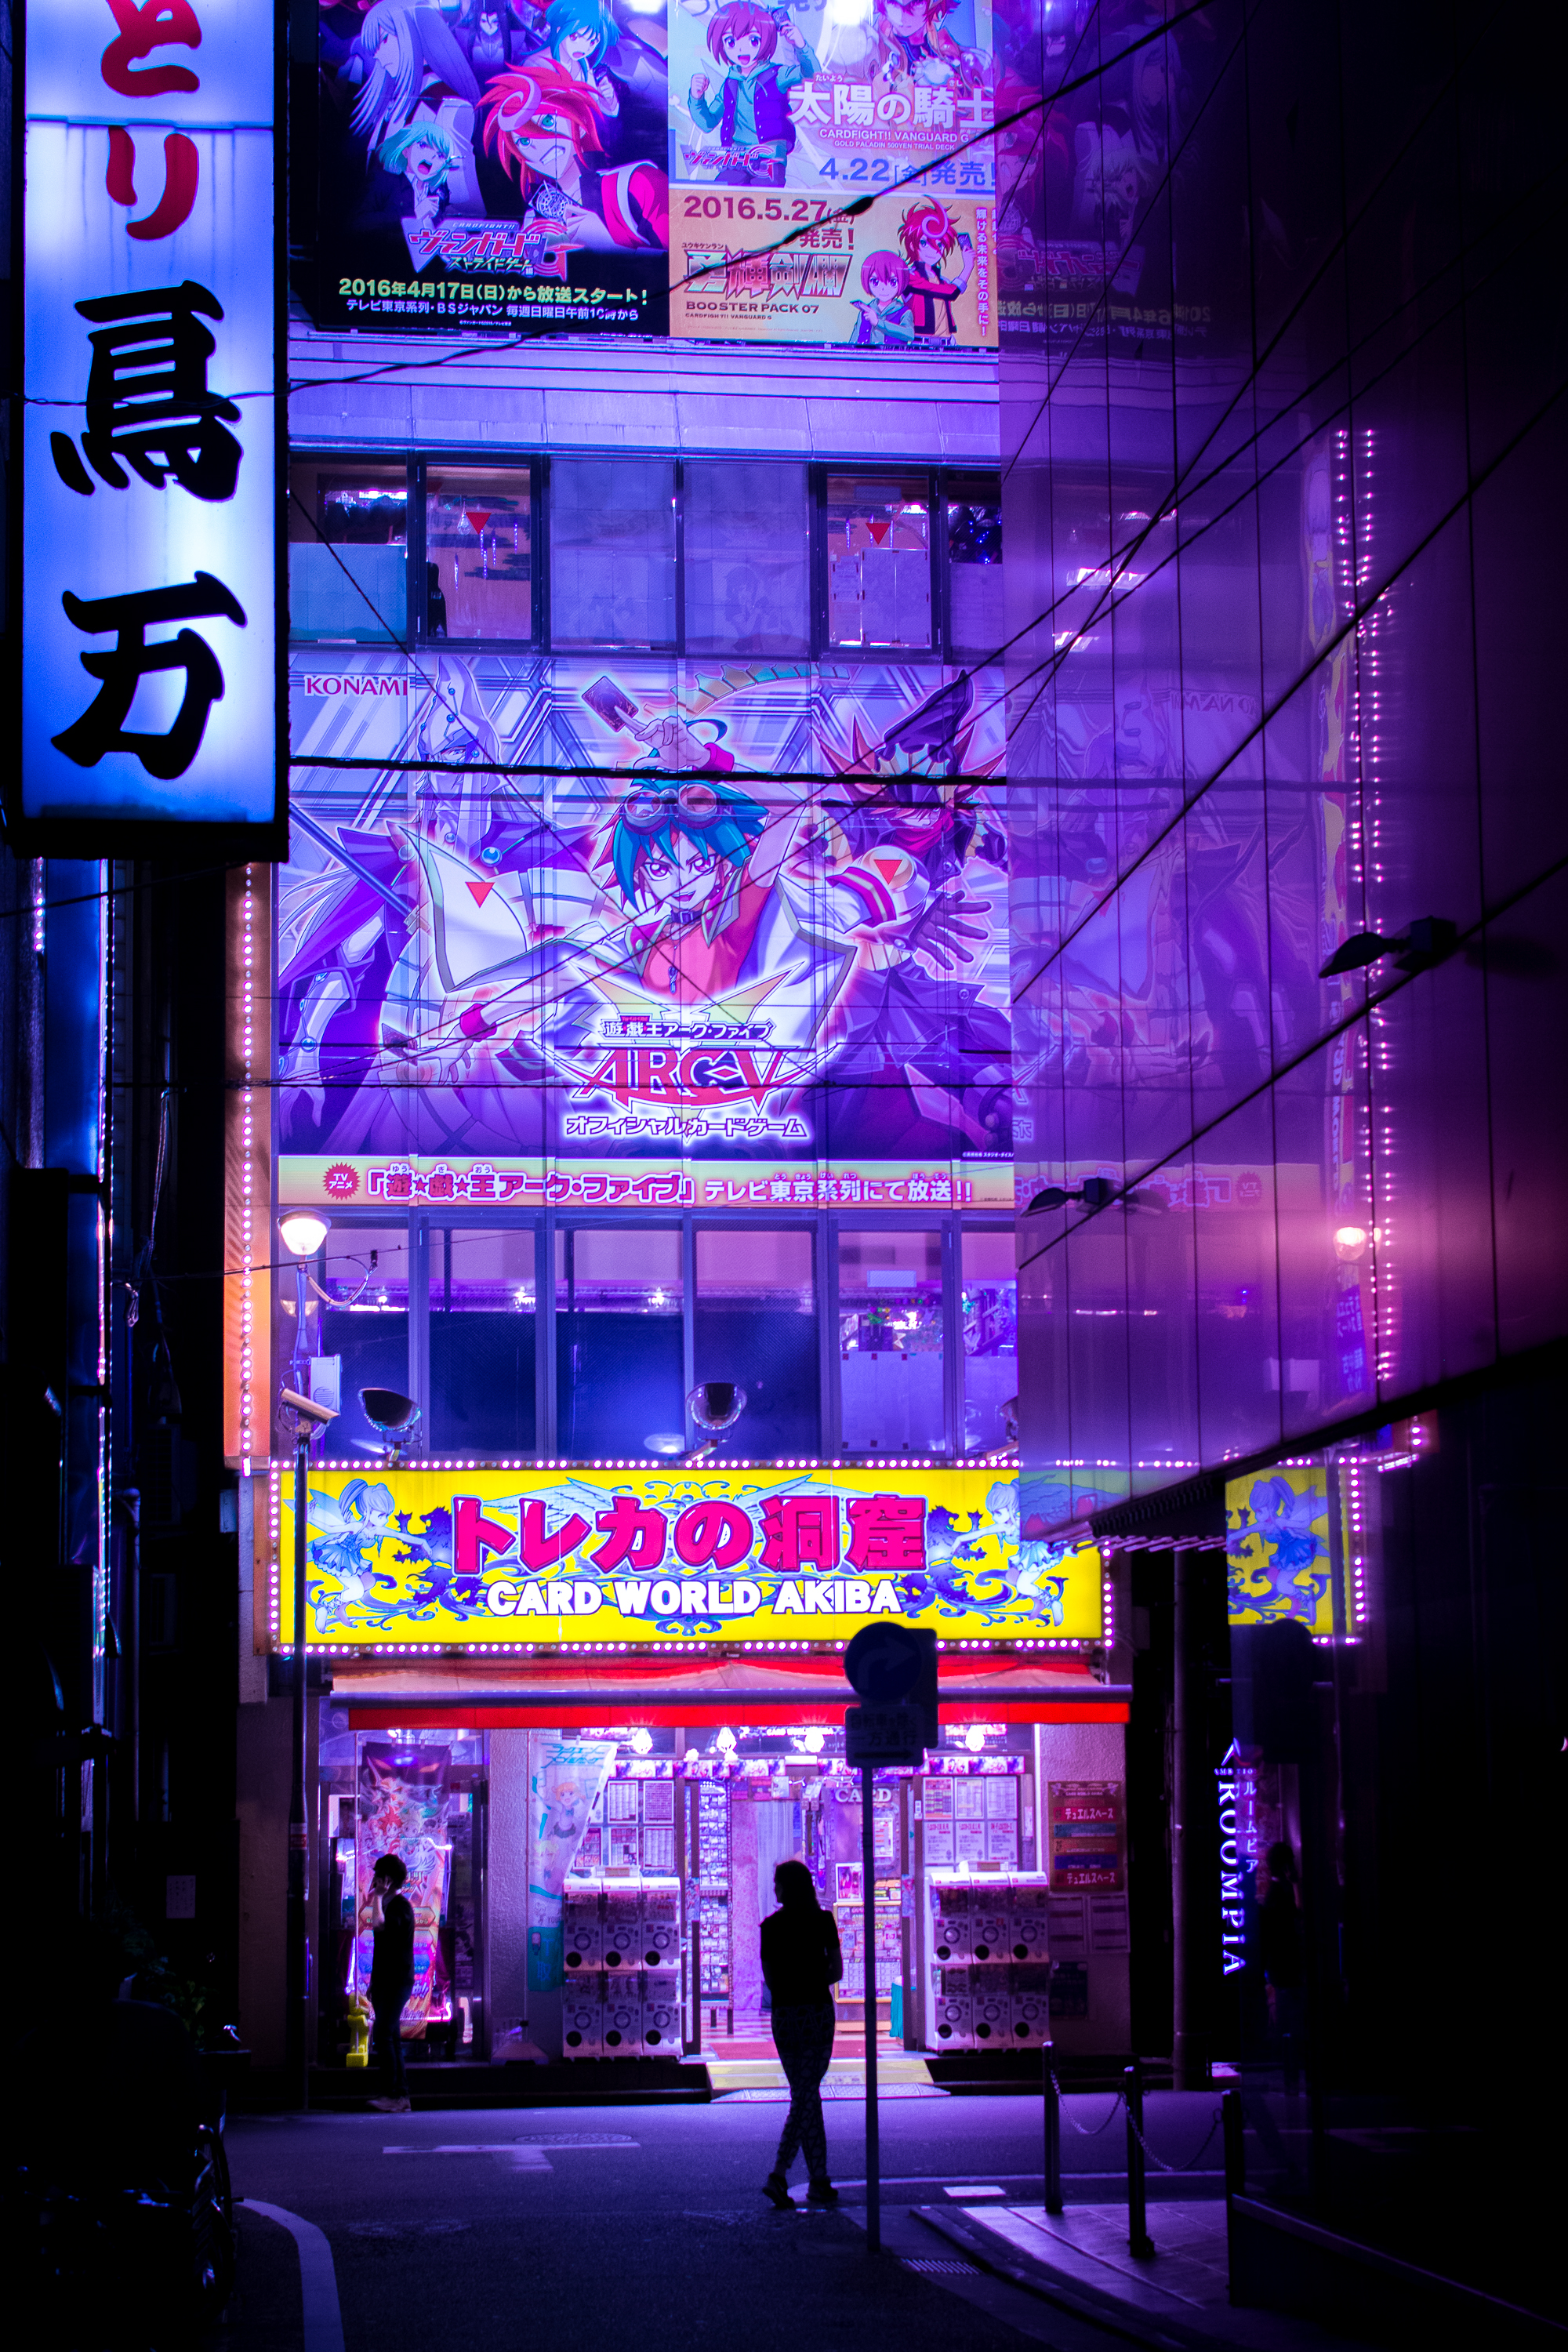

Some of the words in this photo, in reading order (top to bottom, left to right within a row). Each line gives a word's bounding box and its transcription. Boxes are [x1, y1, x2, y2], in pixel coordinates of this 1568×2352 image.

[788, 80, 995, 128] 太陽の騎士
[819, 129, 891, 140] CARDFIGHT!!
[894, 132, 956, 143] VANGUARD
[960, 134, 969, 143] G
[800, 226, 854, 251] 発売!
[339, 278, 648, 306] 2016年4月17日(日)から放送スタート!
[686, 301, 759, 312] BOOSTER
[761, 303, 799, 314] PACK
[801, 305, 819, 314] 07
[307, 677, 408, 696] KONAMI
[567, 1116, 808, 1138] オフィシャルカードゲーム
[328, 1181, 353, 1189] アニメ
[452, 1496, 927, 1575] トレカの洞窟
[487, 1581, 603, 1616] CARD
[613, 1581, 762, 1615] WORLD
[772, 1579, 903, 1614] AKIBA
[835, 1788, 891, 1802] CAD
[1243, 1780, 1259, 1873] ルームピア
